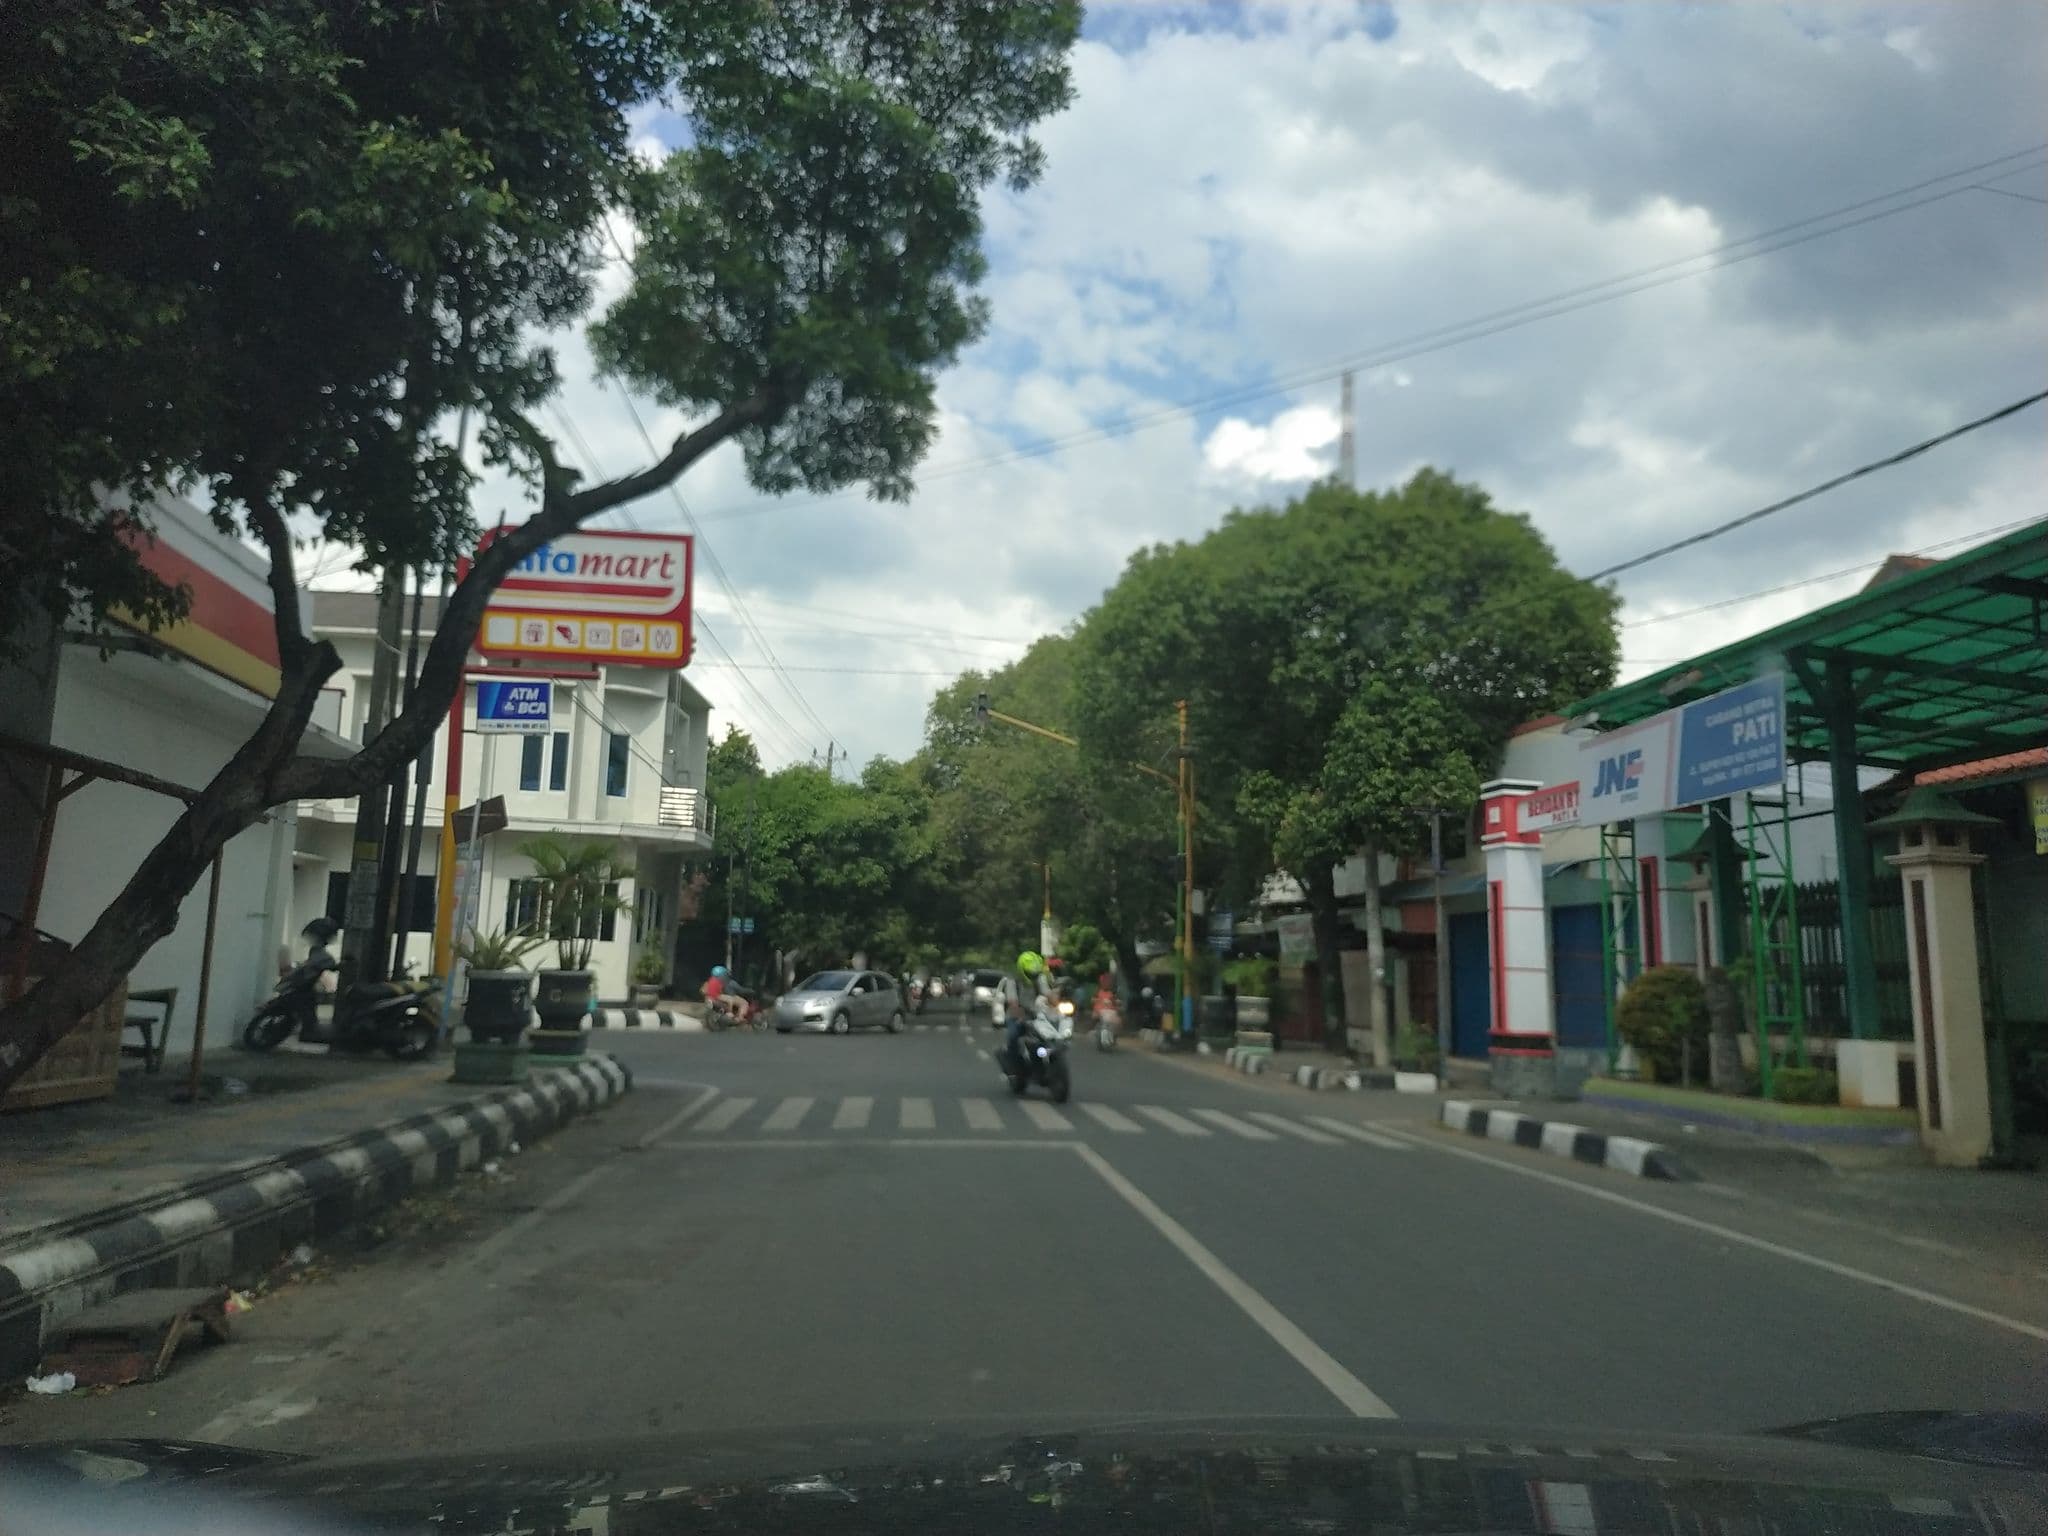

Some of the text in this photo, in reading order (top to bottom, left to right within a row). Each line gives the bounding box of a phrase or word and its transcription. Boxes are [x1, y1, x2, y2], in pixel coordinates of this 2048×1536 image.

[509, 686, 540, 701] ATM
[517, 701, 547, 715] BCA
[1732, 710, 1777, 746] PATI
[1592, 748, 1644, 798] JNE
